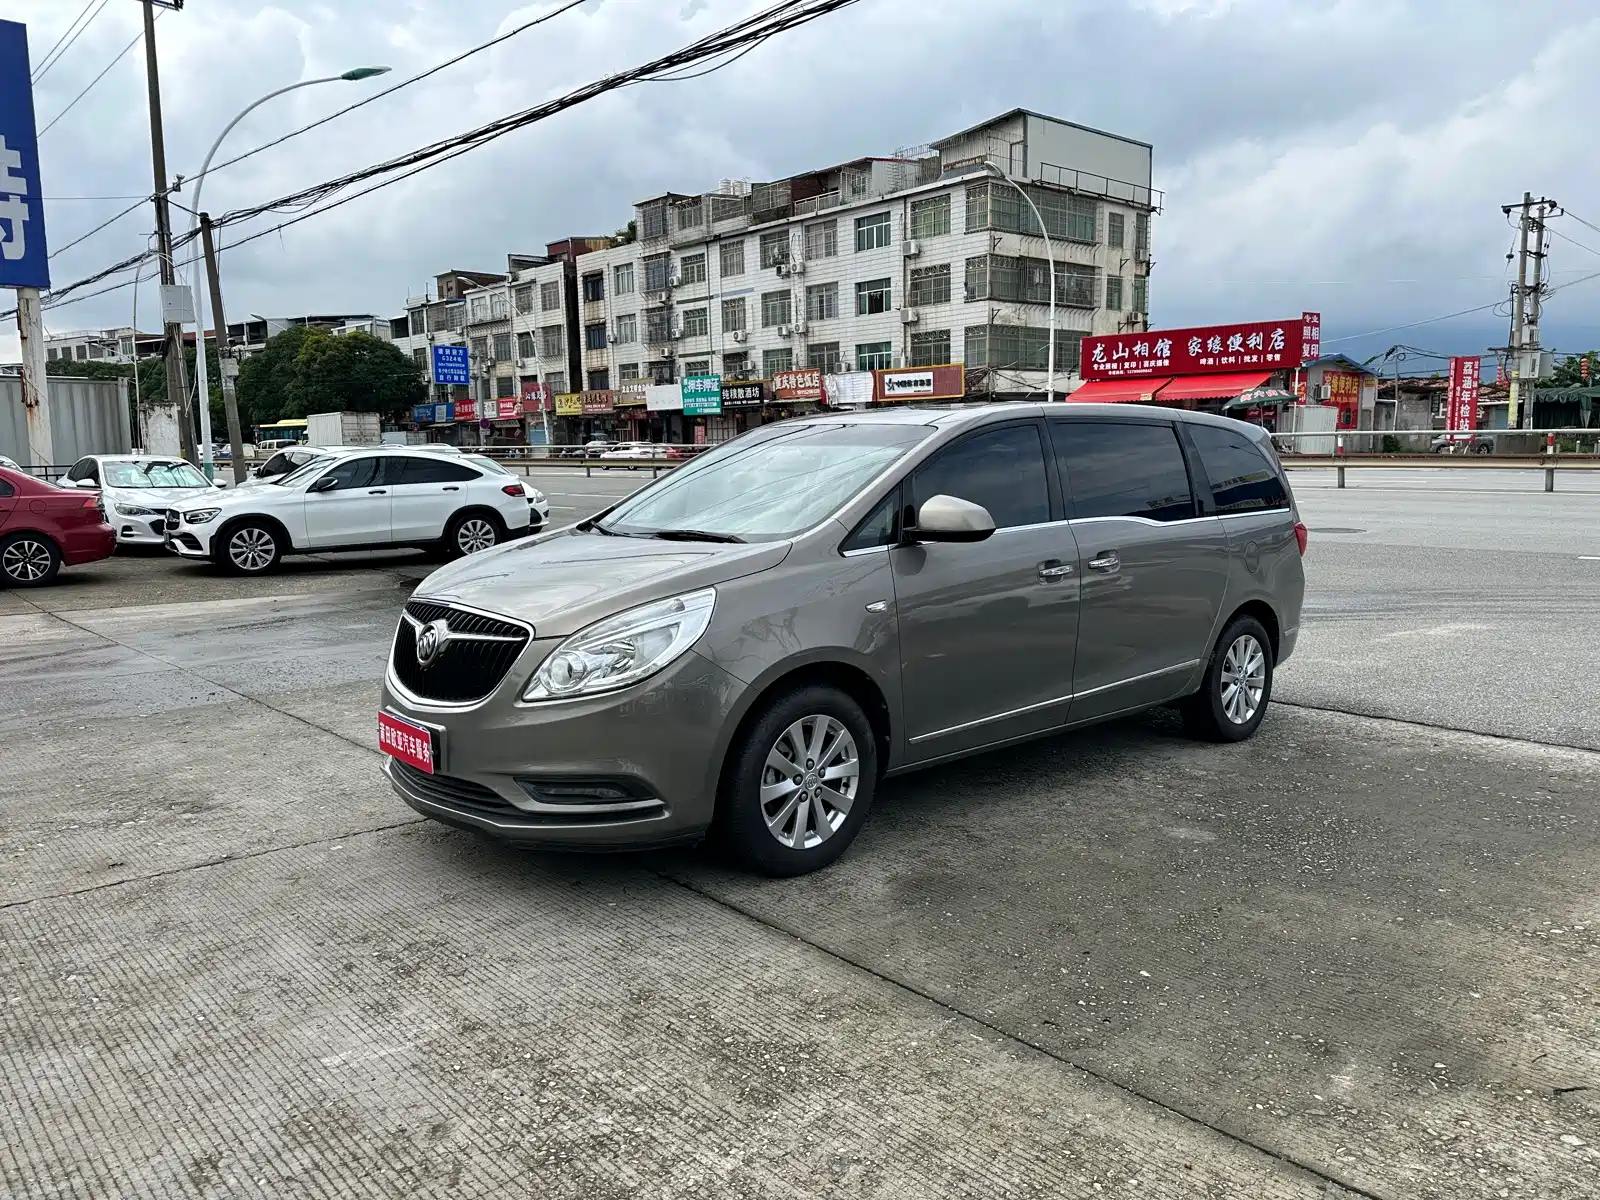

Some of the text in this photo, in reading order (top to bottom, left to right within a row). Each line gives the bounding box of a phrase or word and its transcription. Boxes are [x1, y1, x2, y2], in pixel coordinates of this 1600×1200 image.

[1303, 314, 1319, 323] 专业
[1302, 326, 1320, 340] 照相
[1091, 327, 1286, 363] 龙山相馆 家缘便利店
[1302, 342, 1320, 358] 复印
